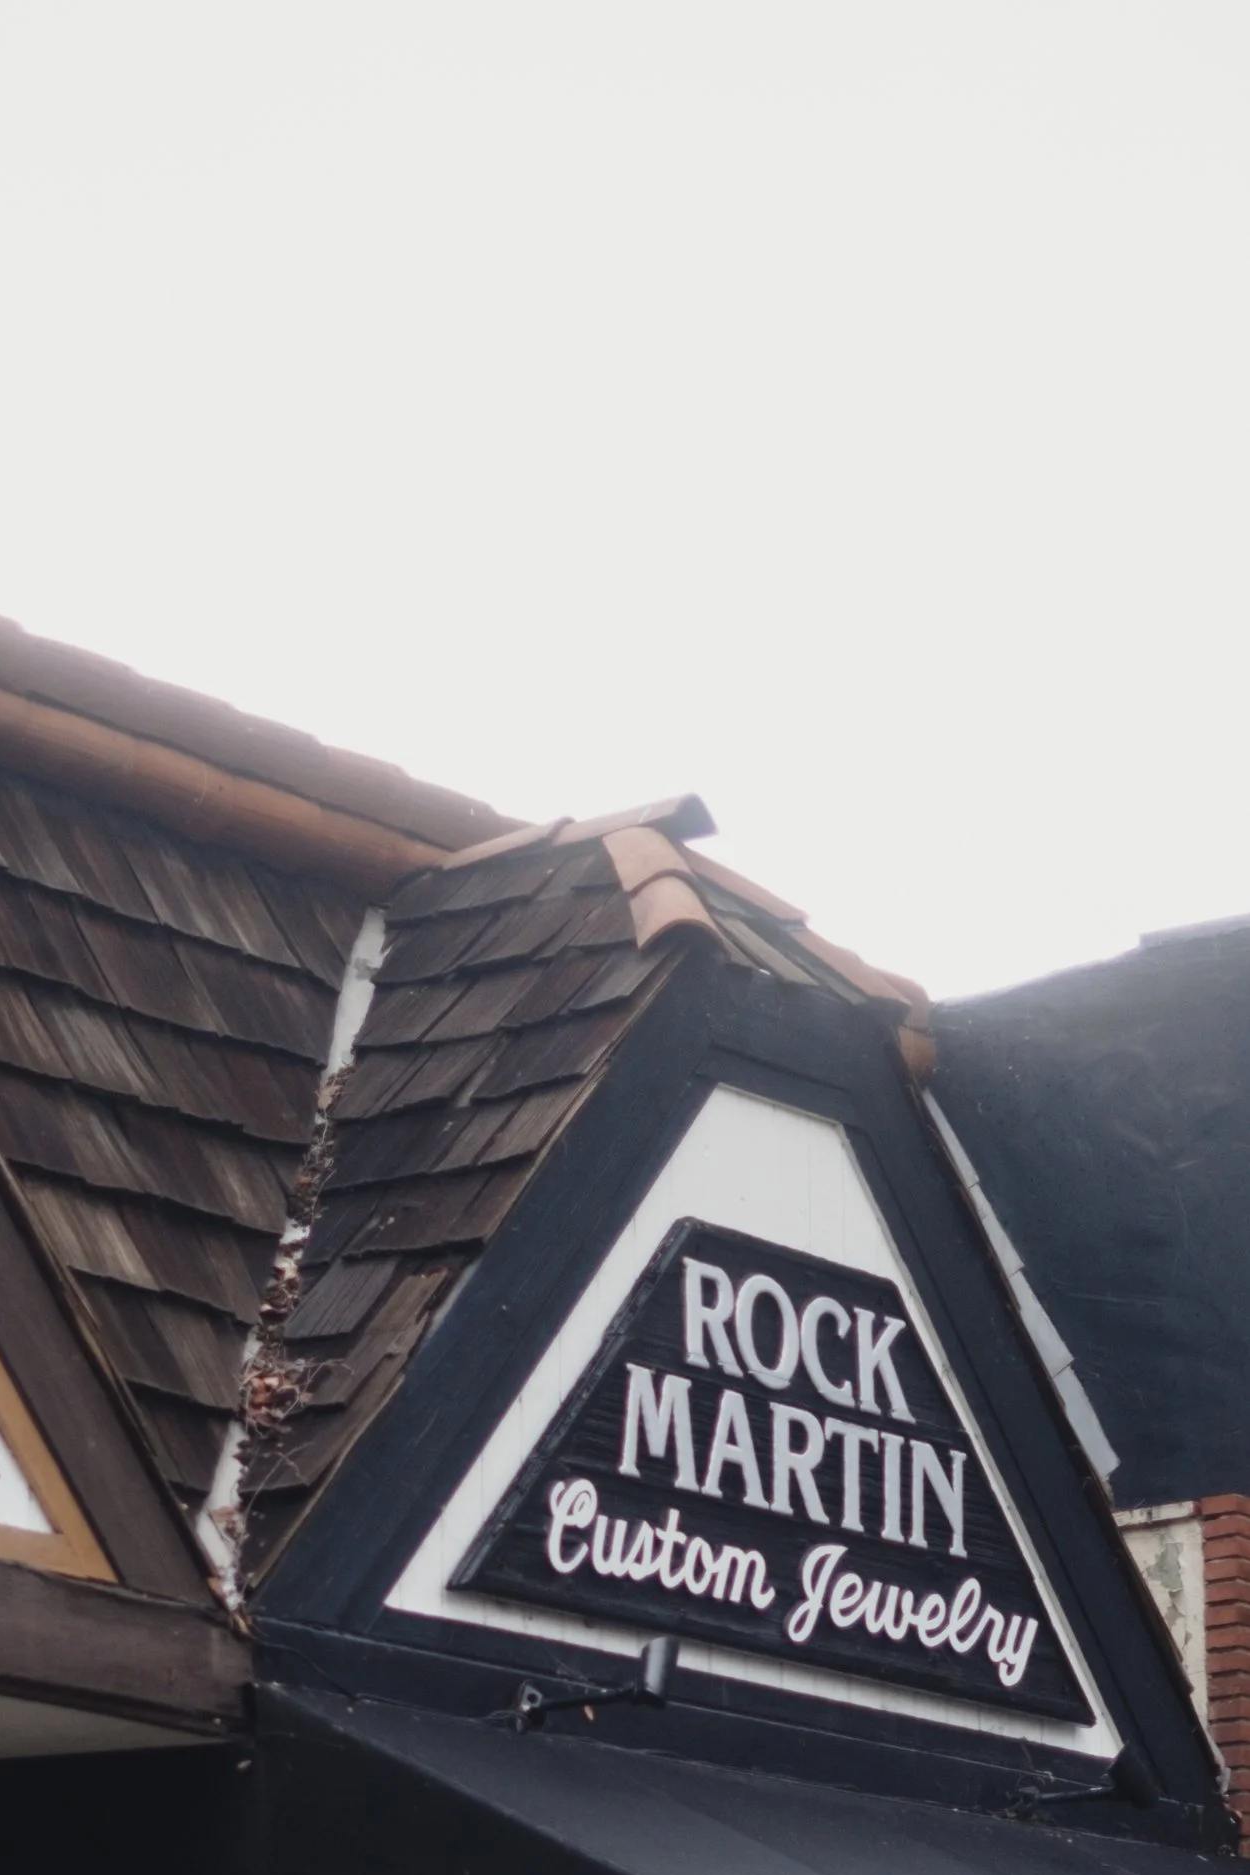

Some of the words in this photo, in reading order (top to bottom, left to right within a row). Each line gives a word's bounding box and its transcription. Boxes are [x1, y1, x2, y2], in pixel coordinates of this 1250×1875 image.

[681, 1255, 918, 1425] ROCK
[617, 1361, 969, 1559] MARTIN
[547, 1478, 776, 1611] Custom
[786, 1543, 1040, 1688] Jewelry
